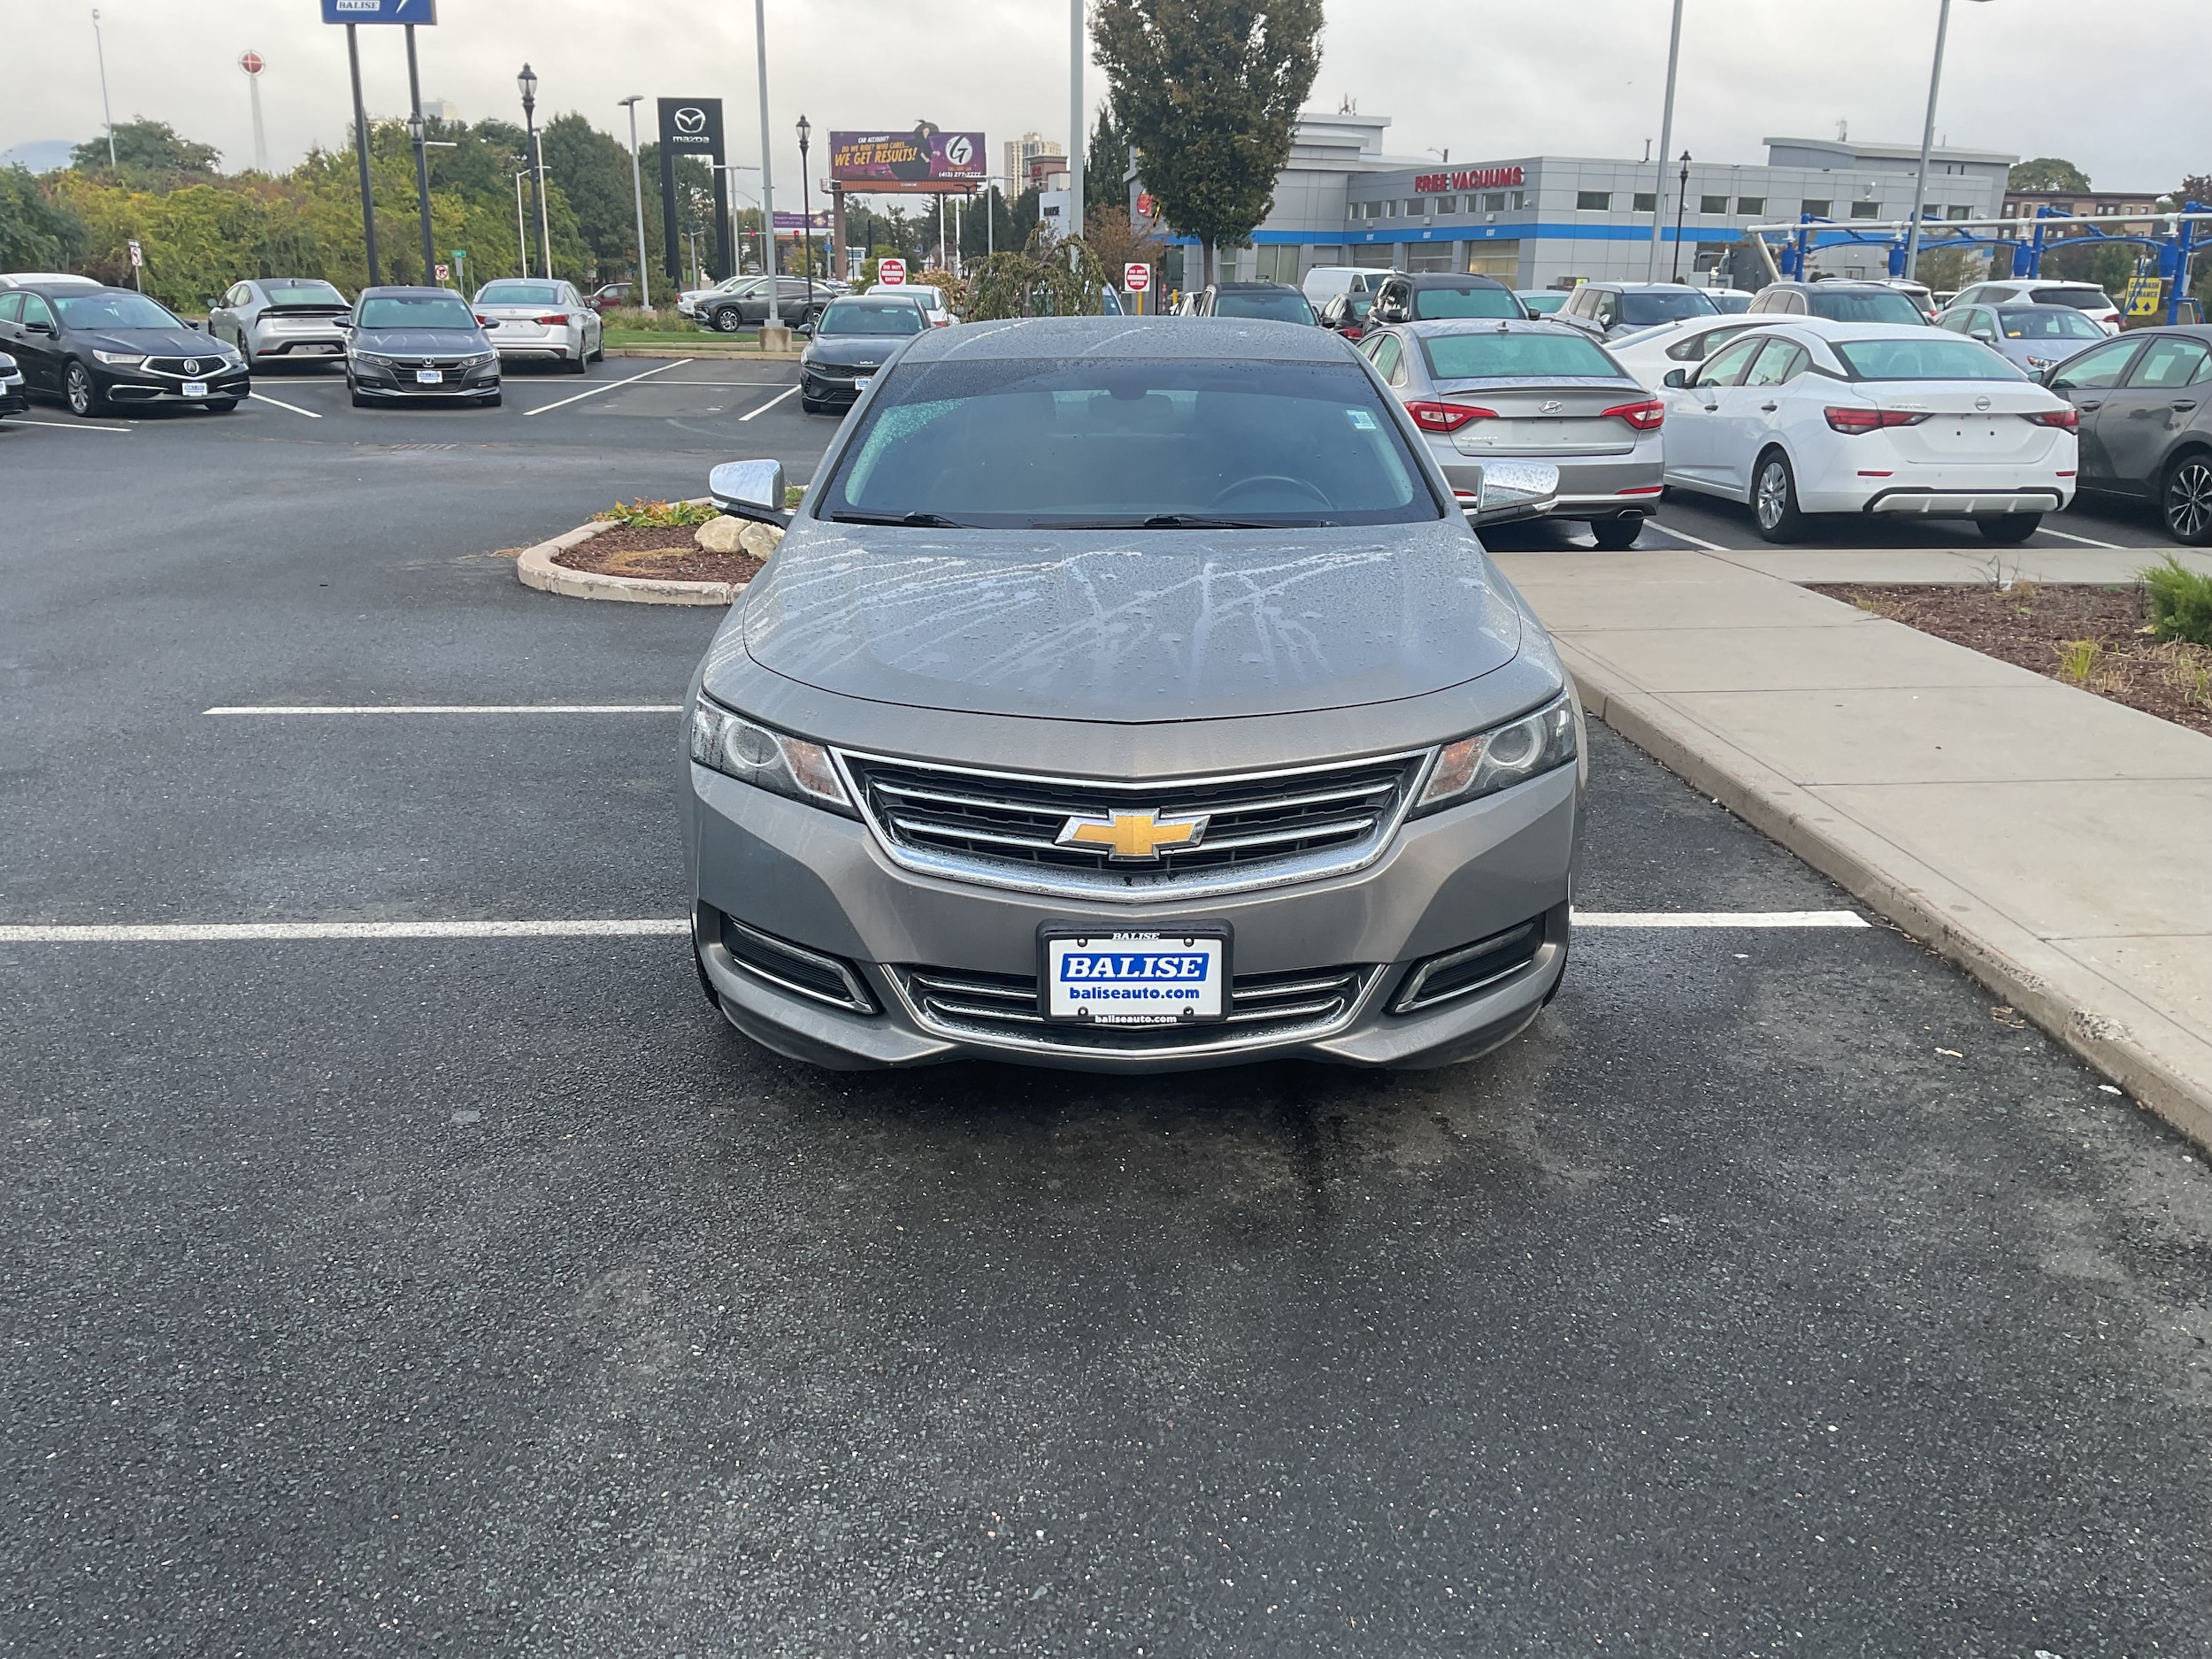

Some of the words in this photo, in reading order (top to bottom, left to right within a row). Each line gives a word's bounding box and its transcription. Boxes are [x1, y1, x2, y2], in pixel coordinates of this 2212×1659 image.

[834, 153, 850, 166] WE
[853, 151, 872, 165] GET
[874, 147, 918, 163] RESULTS!
[1415, 173, 1451, 192] FREE
[1452, 166, 1525, 189] VACUUMS
[1111, 932, 1160, 941] BALISE
[1066, 956, 1203, 978] BALISE
[1069, 987, 1200, 999] baliseauto.com
[1094, 1015, 1178, 1024] baliseauto.com
